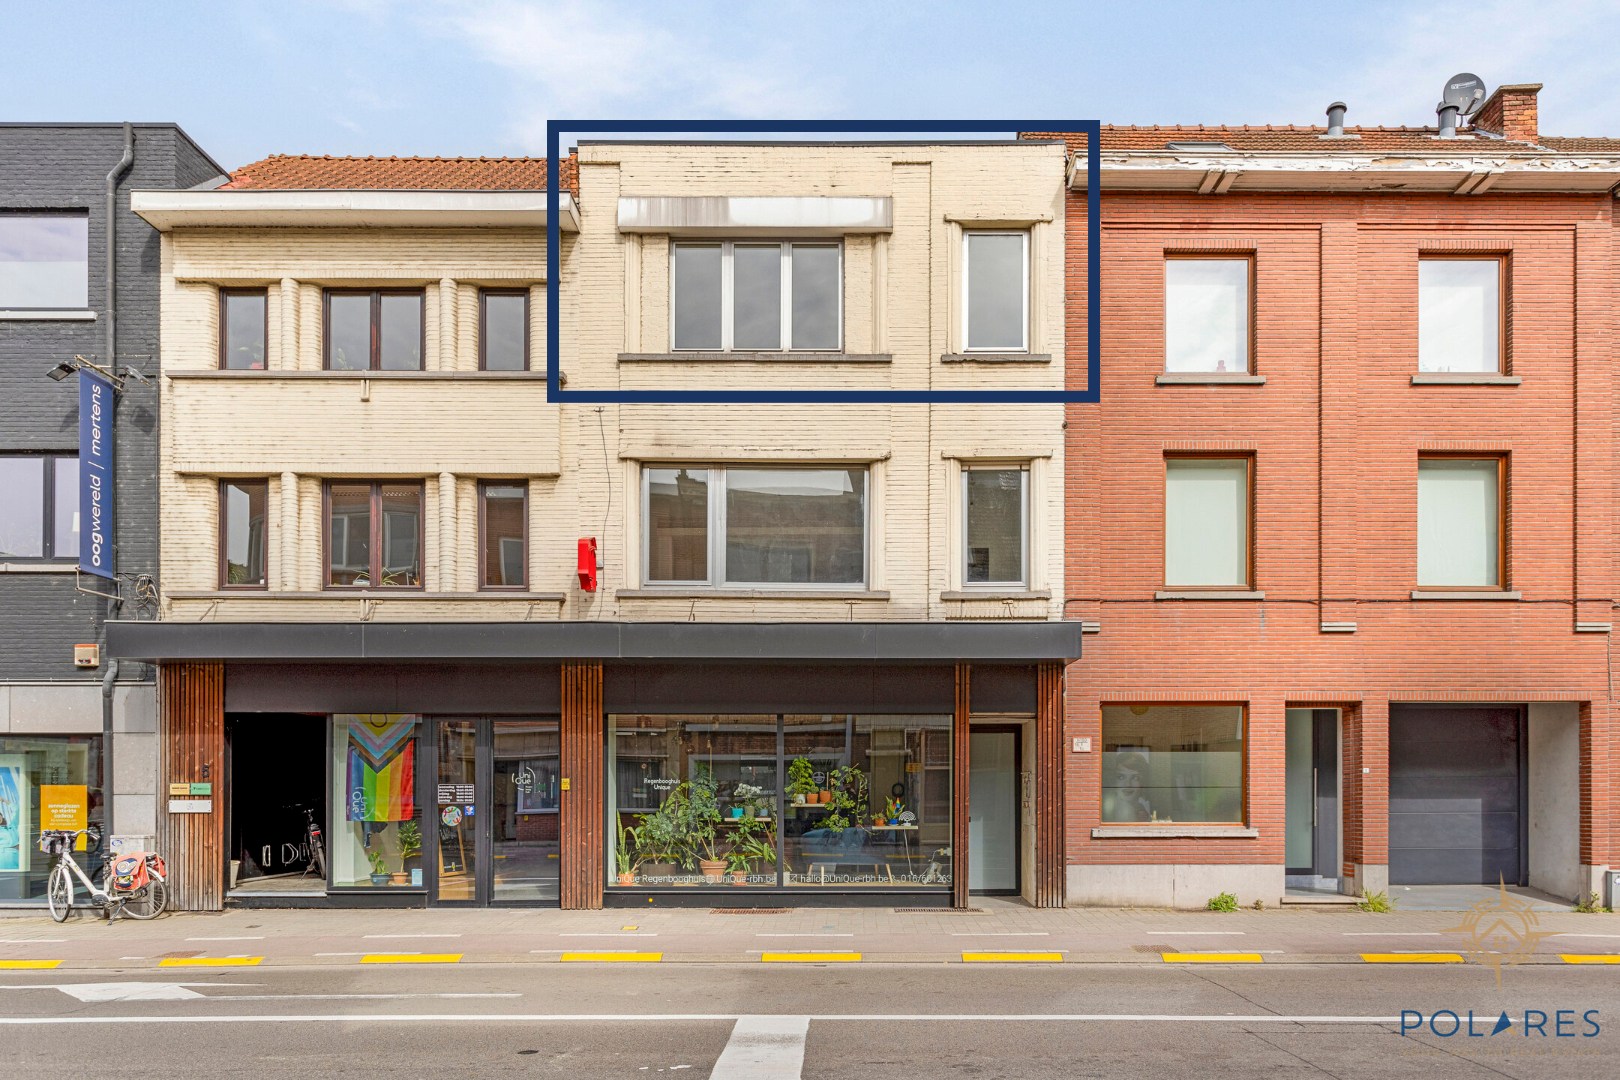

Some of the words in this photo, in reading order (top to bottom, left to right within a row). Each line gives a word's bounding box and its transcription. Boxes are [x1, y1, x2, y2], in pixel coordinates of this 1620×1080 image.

[91, 384, 101, 456] mertens
[90, 474, 103, 566] oogwereld
[642, 874, 705, 885] Regenbooghuis
